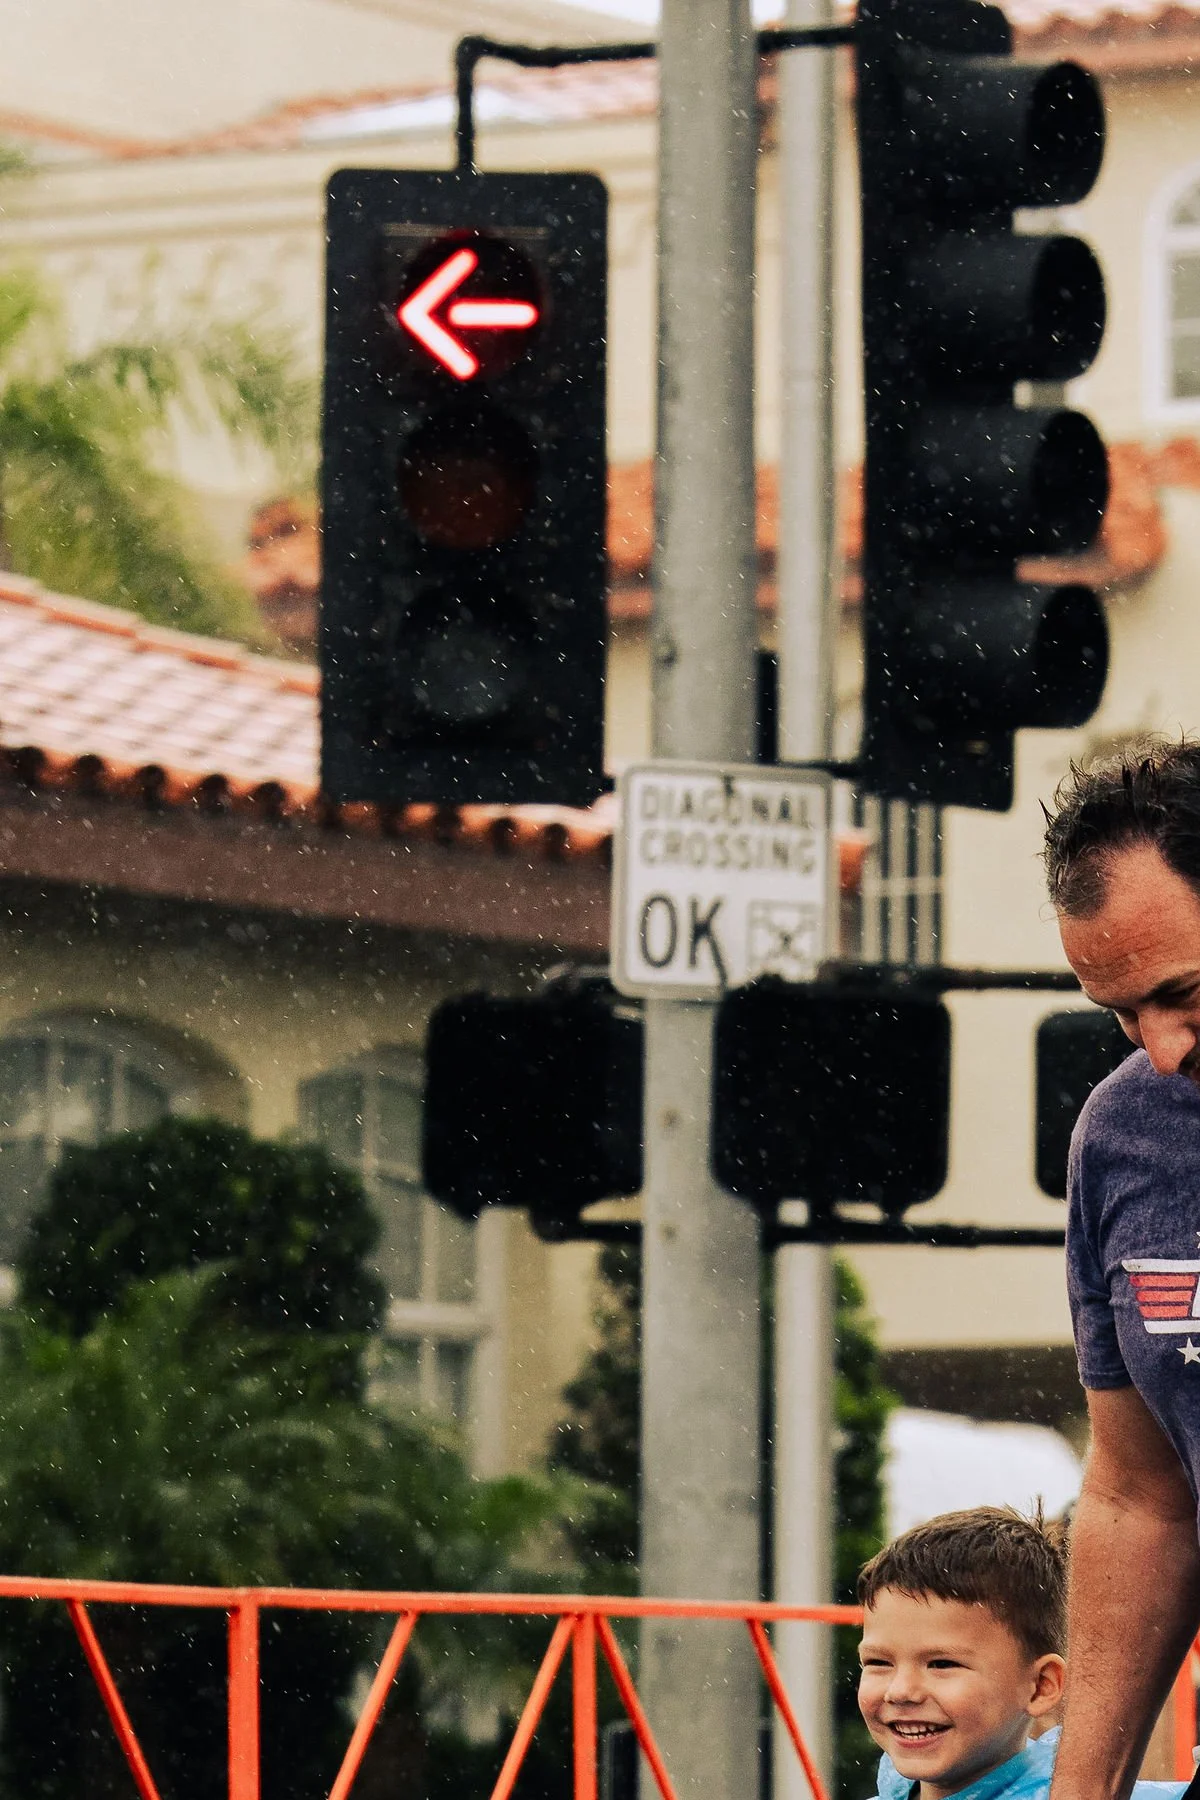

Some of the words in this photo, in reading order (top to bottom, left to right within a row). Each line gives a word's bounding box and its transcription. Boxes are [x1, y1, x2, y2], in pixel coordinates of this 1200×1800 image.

[640, 784, 812, 829] DIAGONAL
[640, 829, 816, 875] CROSSING
[639, 896, 727, 971] OK
